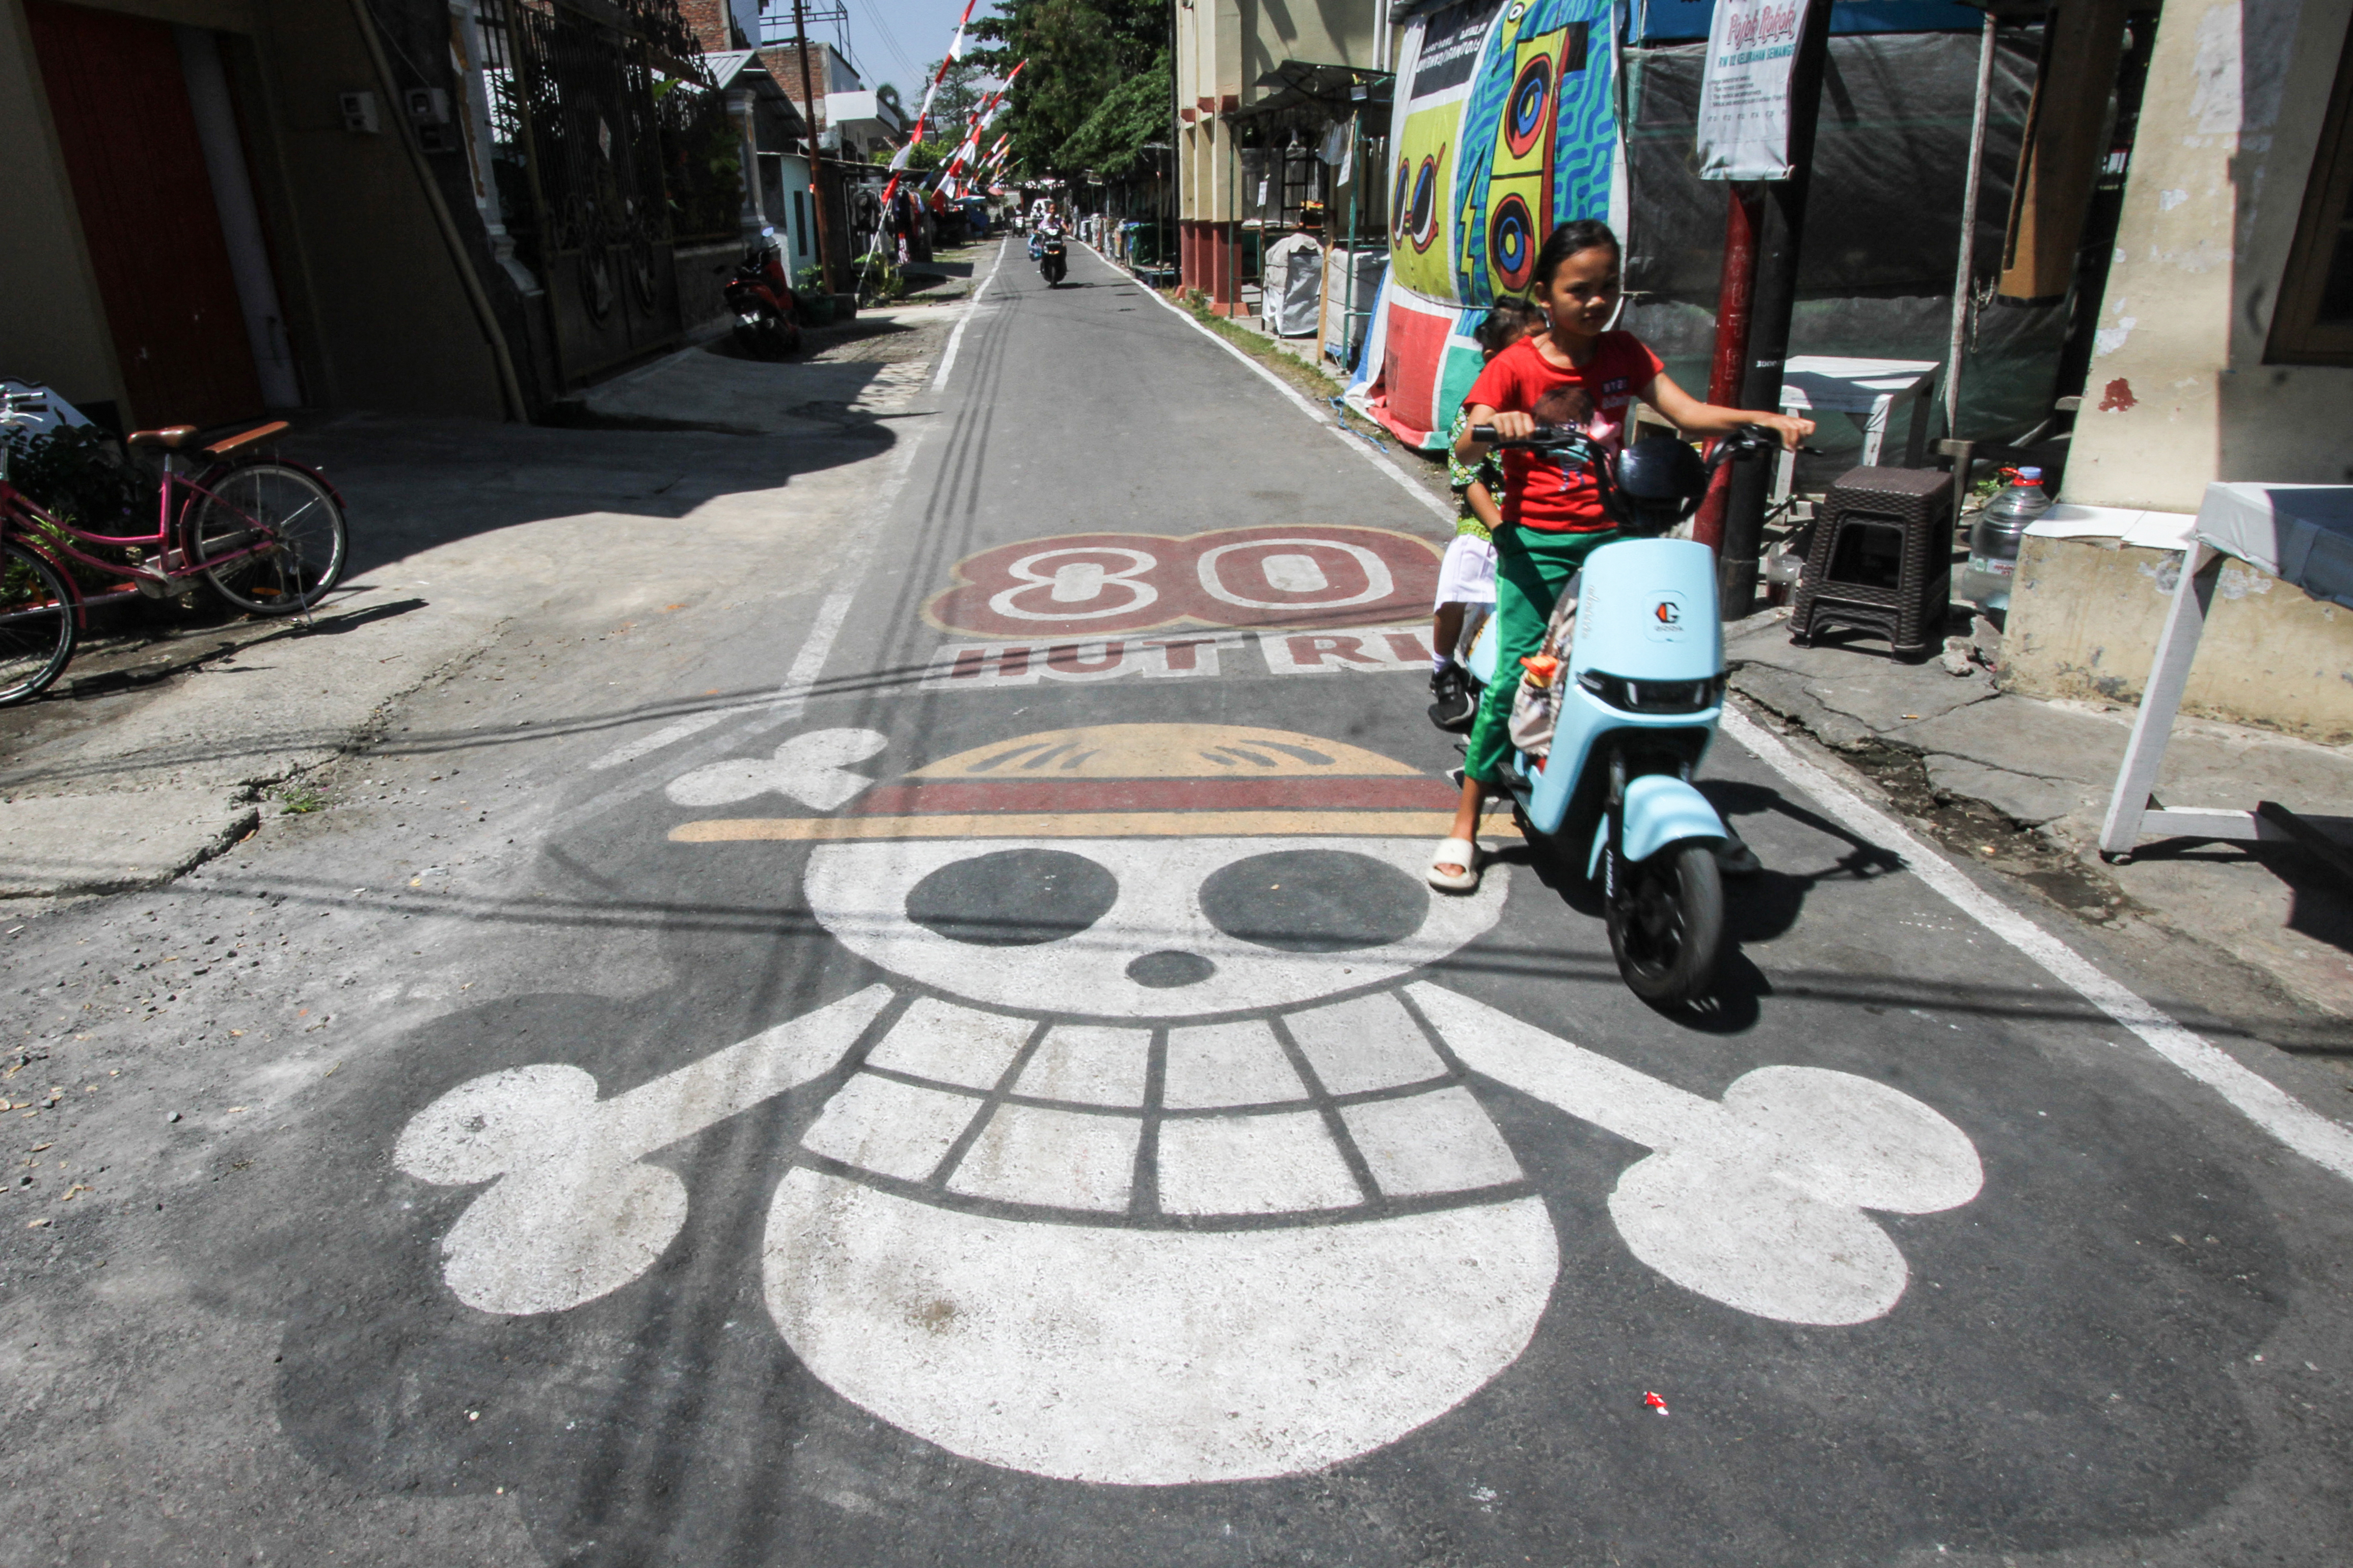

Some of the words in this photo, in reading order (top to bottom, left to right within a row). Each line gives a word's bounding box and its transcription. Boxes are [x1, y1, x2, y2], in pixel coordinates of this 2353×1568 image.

[1727, 9, 1759, 50] Pojok
[1758, 1, 1796, 44] Rokok
[1718, 56, 1728, 68] RW
[1737, 49, 1766, 65] KELURAHAN
[987, 537, 1395, 622] 80
[946, 637, 1219, 682] HUT
[1284, 632, 1434, 667] RI
